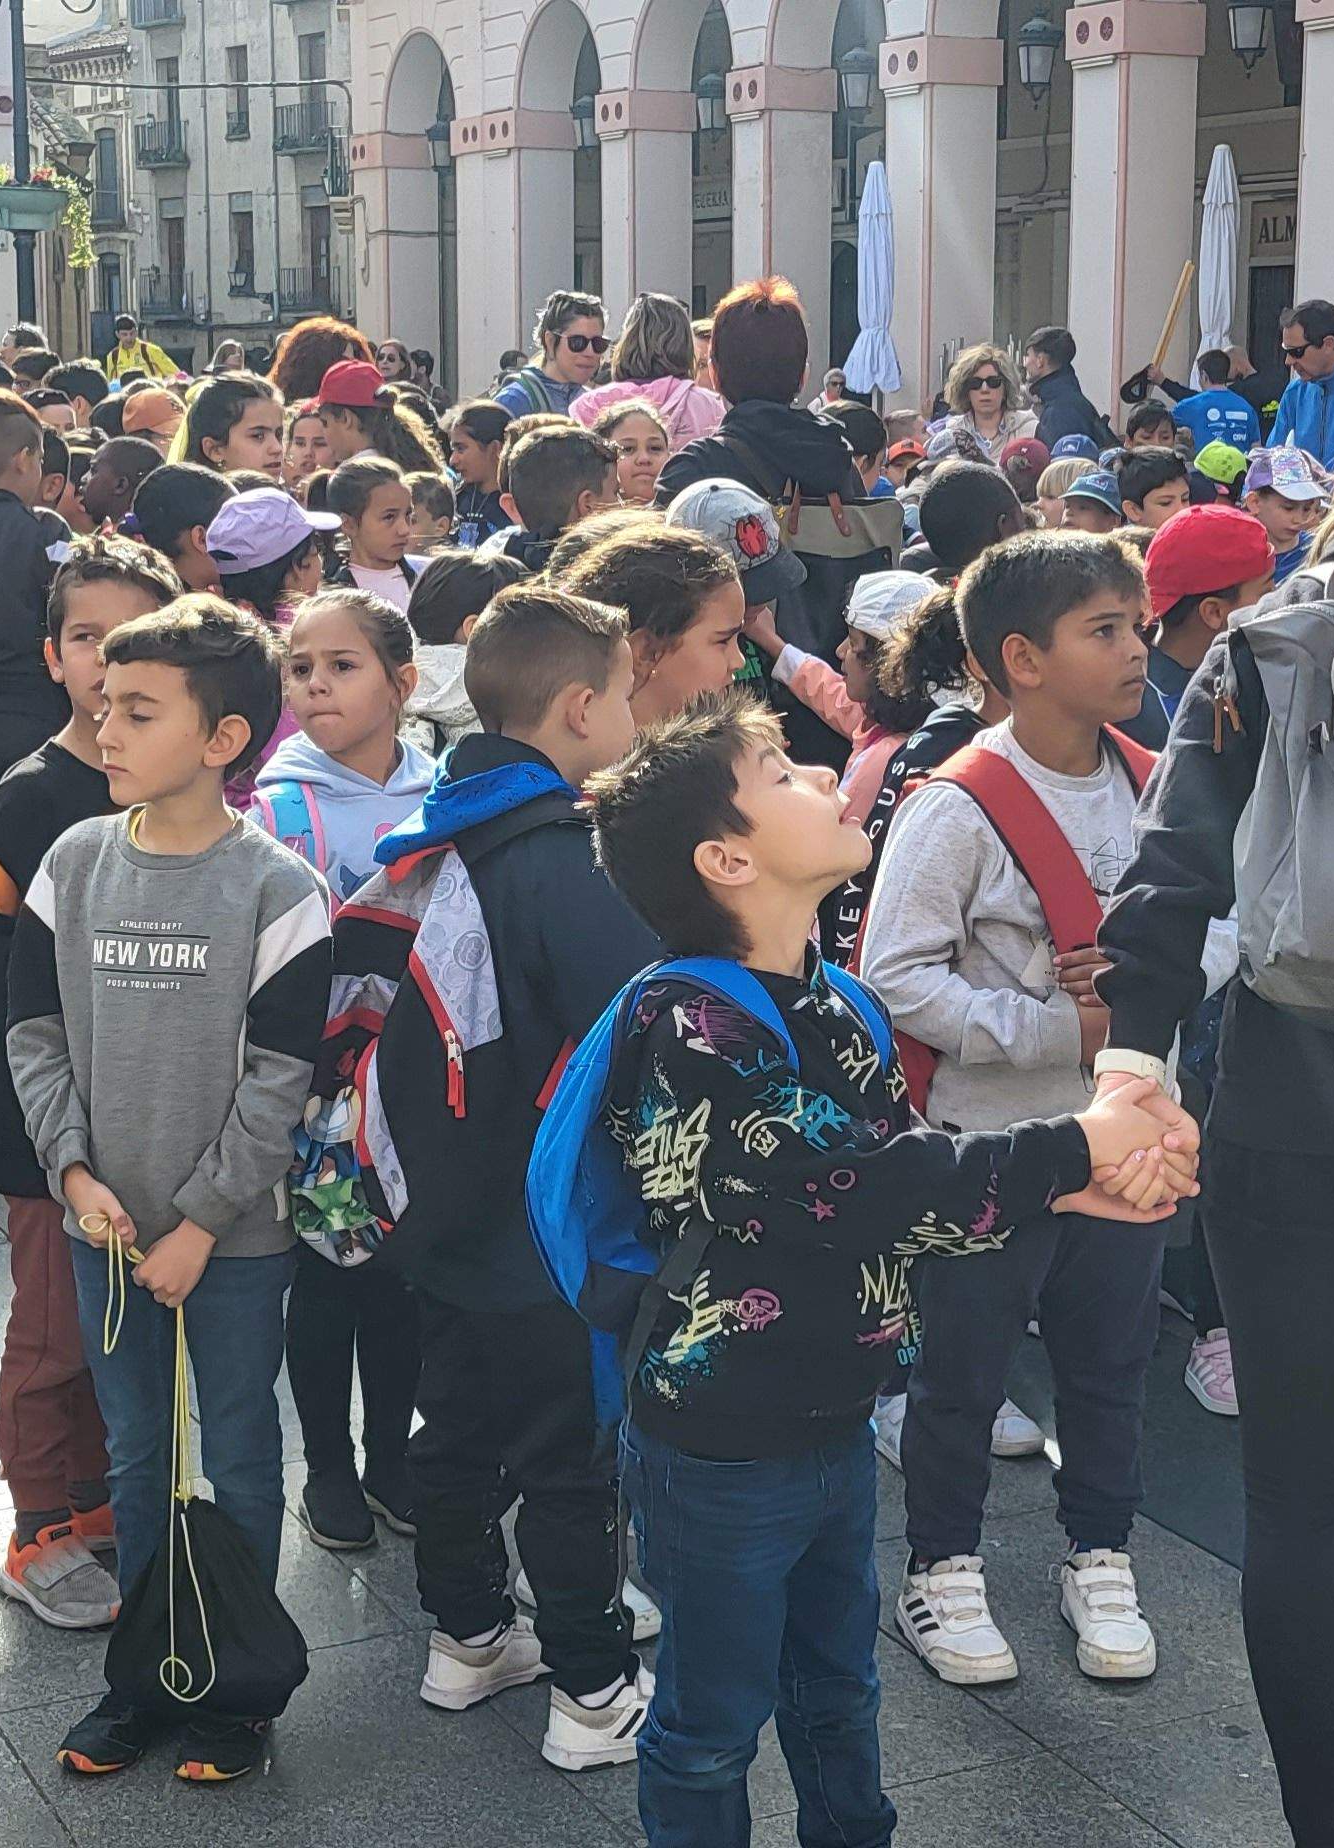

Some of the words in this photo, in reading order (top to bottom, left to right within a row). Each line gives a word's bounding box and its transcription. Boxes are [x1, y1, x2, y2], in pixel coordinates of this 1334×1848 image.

[119, 919, 159, 930] ATHLETICS
[92, 938, 141, 966] NEW
[147, 942, 210, 970] YORK
[106, 978, 128, 988] PUSH
[130, 979, 150, 989] YOUR
[152, 981, 181, 991] LIMITS
